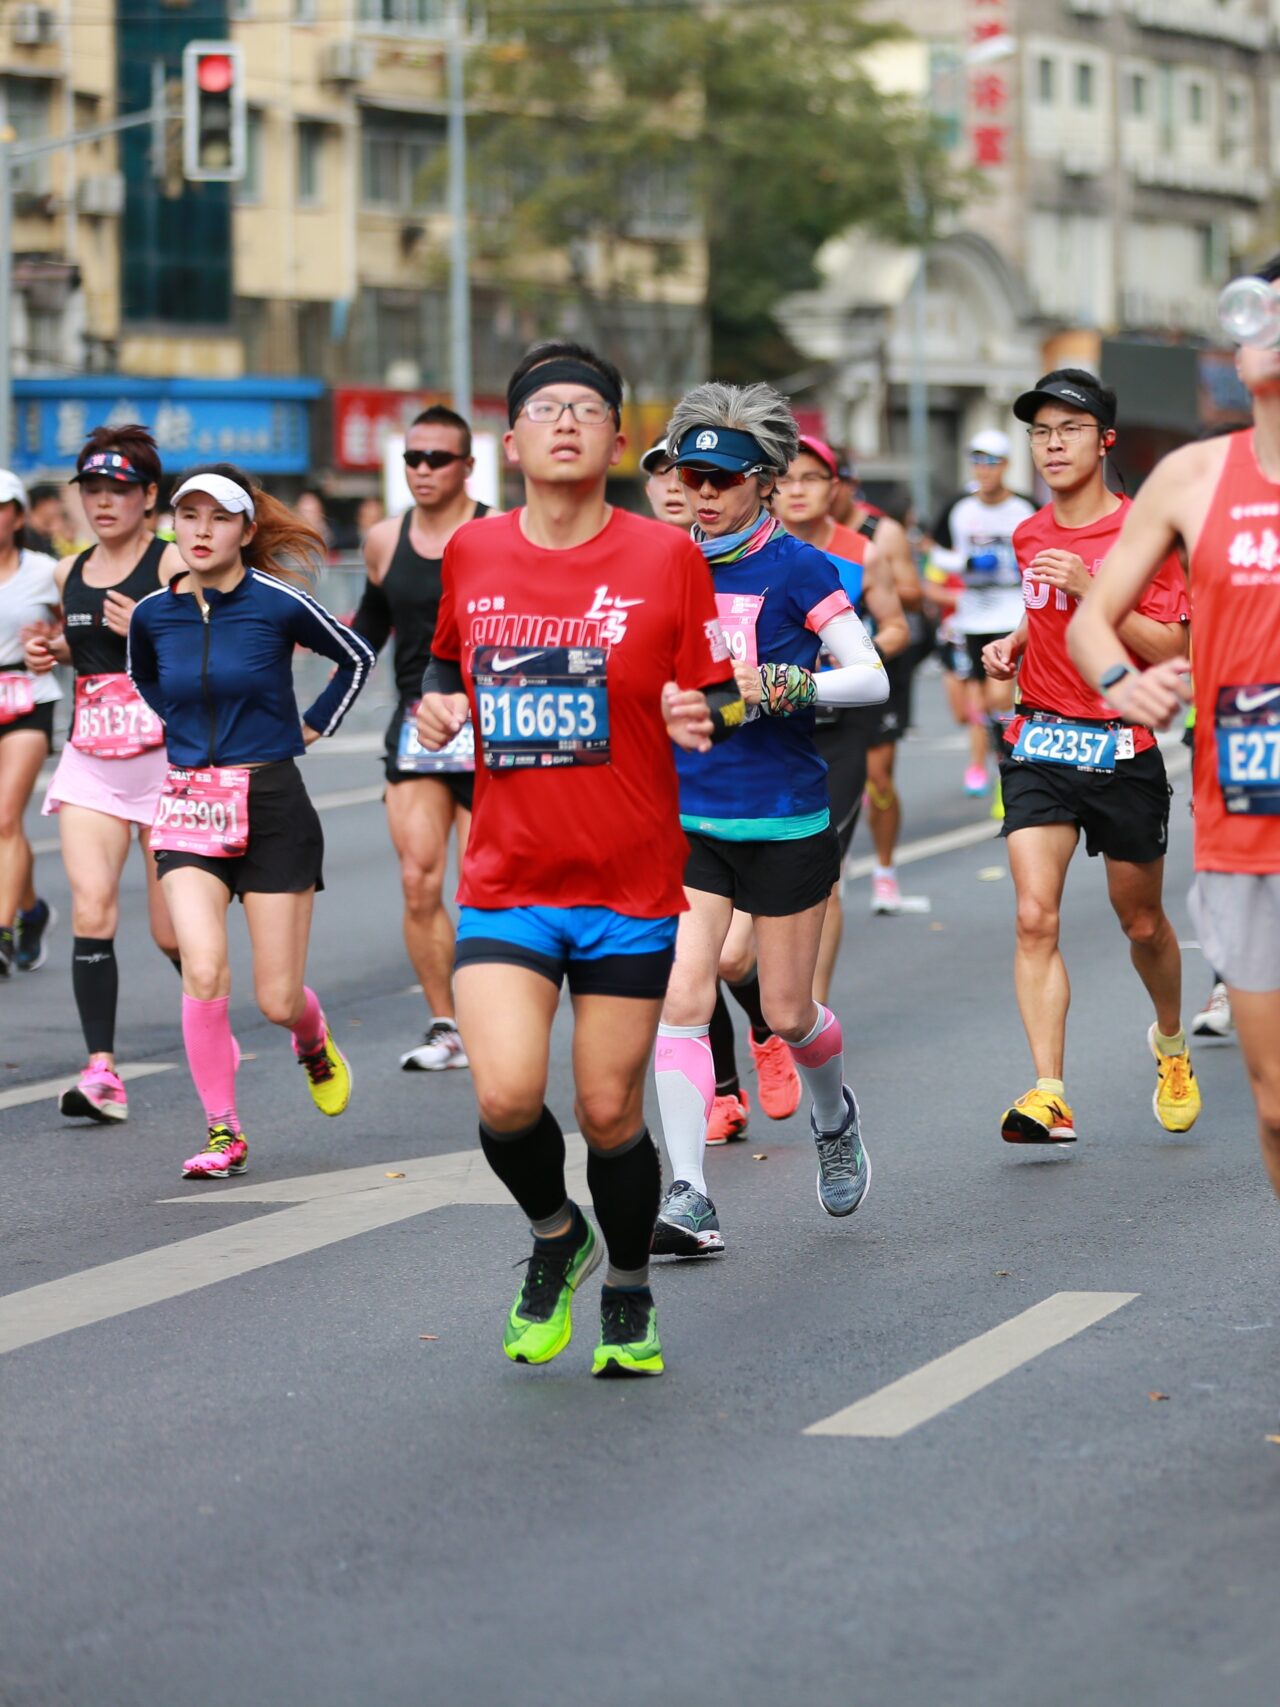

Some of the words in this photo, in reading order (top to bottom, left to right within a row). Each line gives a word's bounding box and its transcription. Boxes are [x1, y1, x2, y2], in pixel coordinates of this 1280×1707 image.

[79, 701, 154, 738] B51373
[480, 693, 597, 737] B16653
[1023, 726, 1109, 764] C22357
[154, 796, 238, 833] D53901
